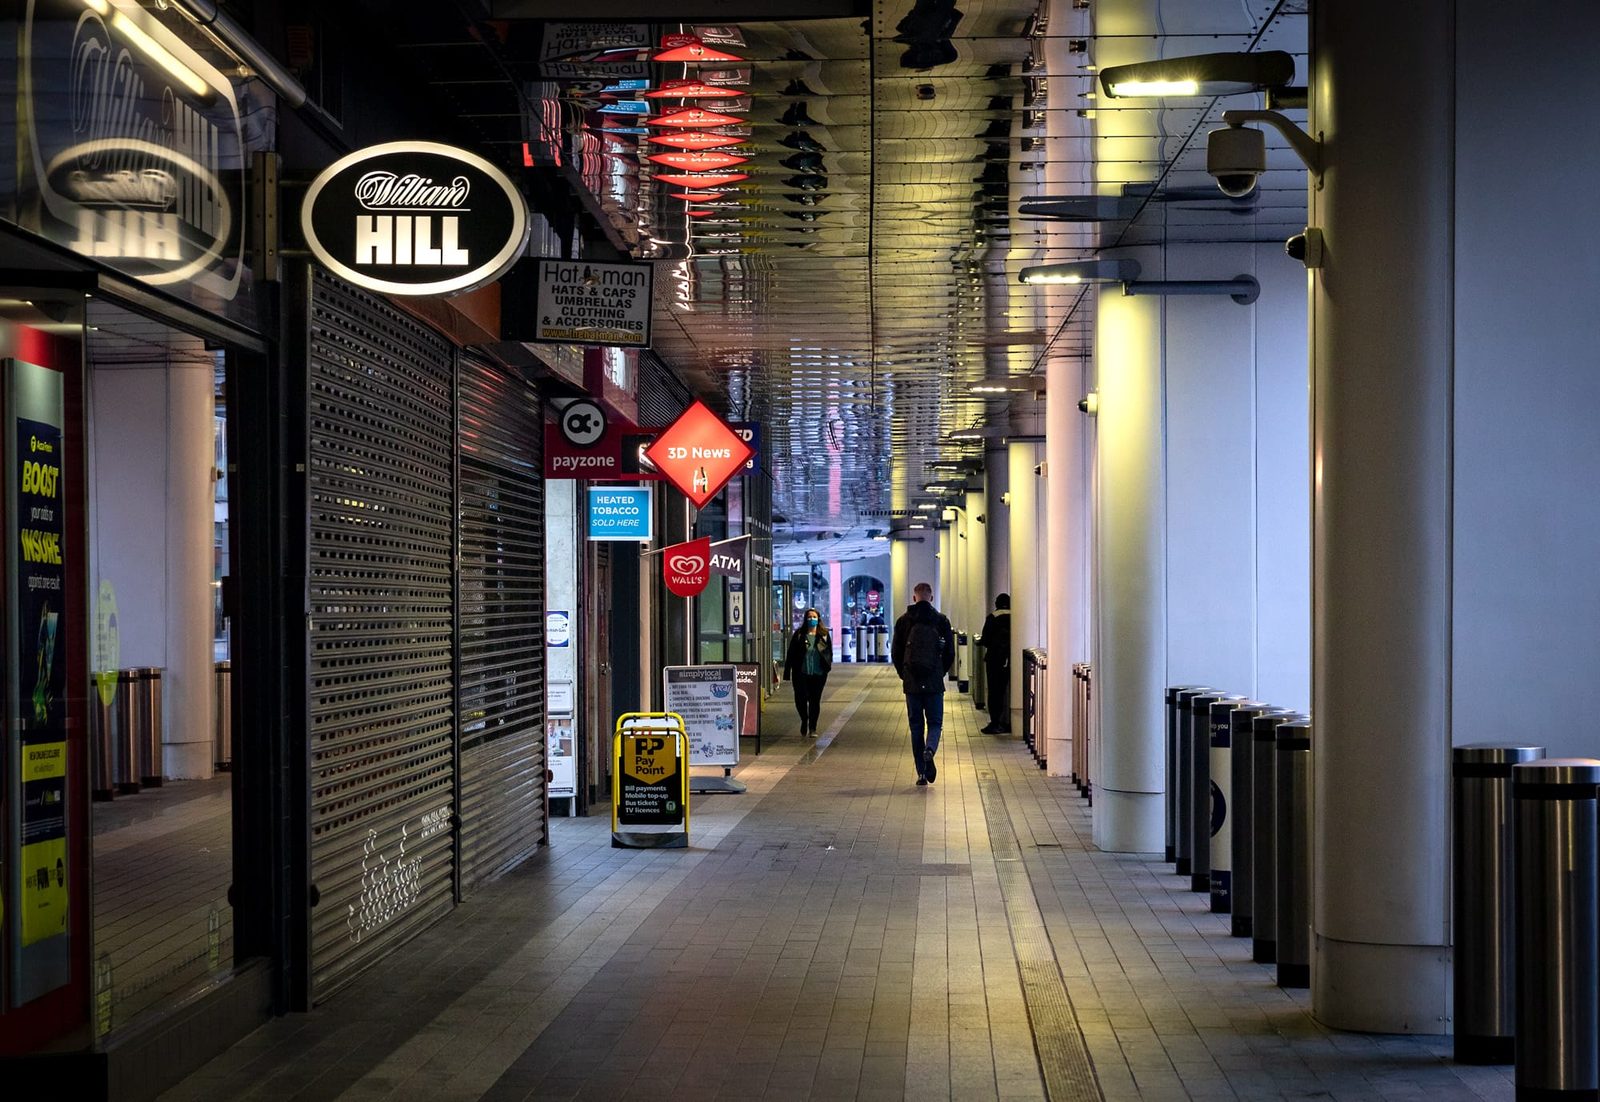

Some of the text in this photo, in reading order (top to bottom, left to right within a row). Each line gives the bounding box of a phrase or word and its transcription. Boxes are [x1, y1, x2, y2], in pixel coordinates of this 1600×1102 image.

[355, 171, 470, 211] William
[356, 215, 469, 265] HILL
[551, 285, 636, 298] HATS & CAPS
[555, 295, 632, 308] UMBRELLAS
[561, 306, 625, 318] CLOTHING
[542, 316, 643, 330] & ACCESSORIES
[542, 328, 643, 341] www.thehatman.com
[667, 447, 687, 459] 3D
[692, 447, 731, 459] News
[553, 456, 615, 470] payzone
[22, 460, 59, 498] BOOST
[597, 496, 635, 504] HEATED
[592, 506, 639, 515] TOBACCO
[592, 519, 640, 527] SOLD HERE
[21, 528, 62, 564] INSURE
[709, 554, 741, 572] ATM
[672, 576, 703, 585] WALL'S
[635, 756, 655, 767] Pay
[635, 765, 665, 775] Point
